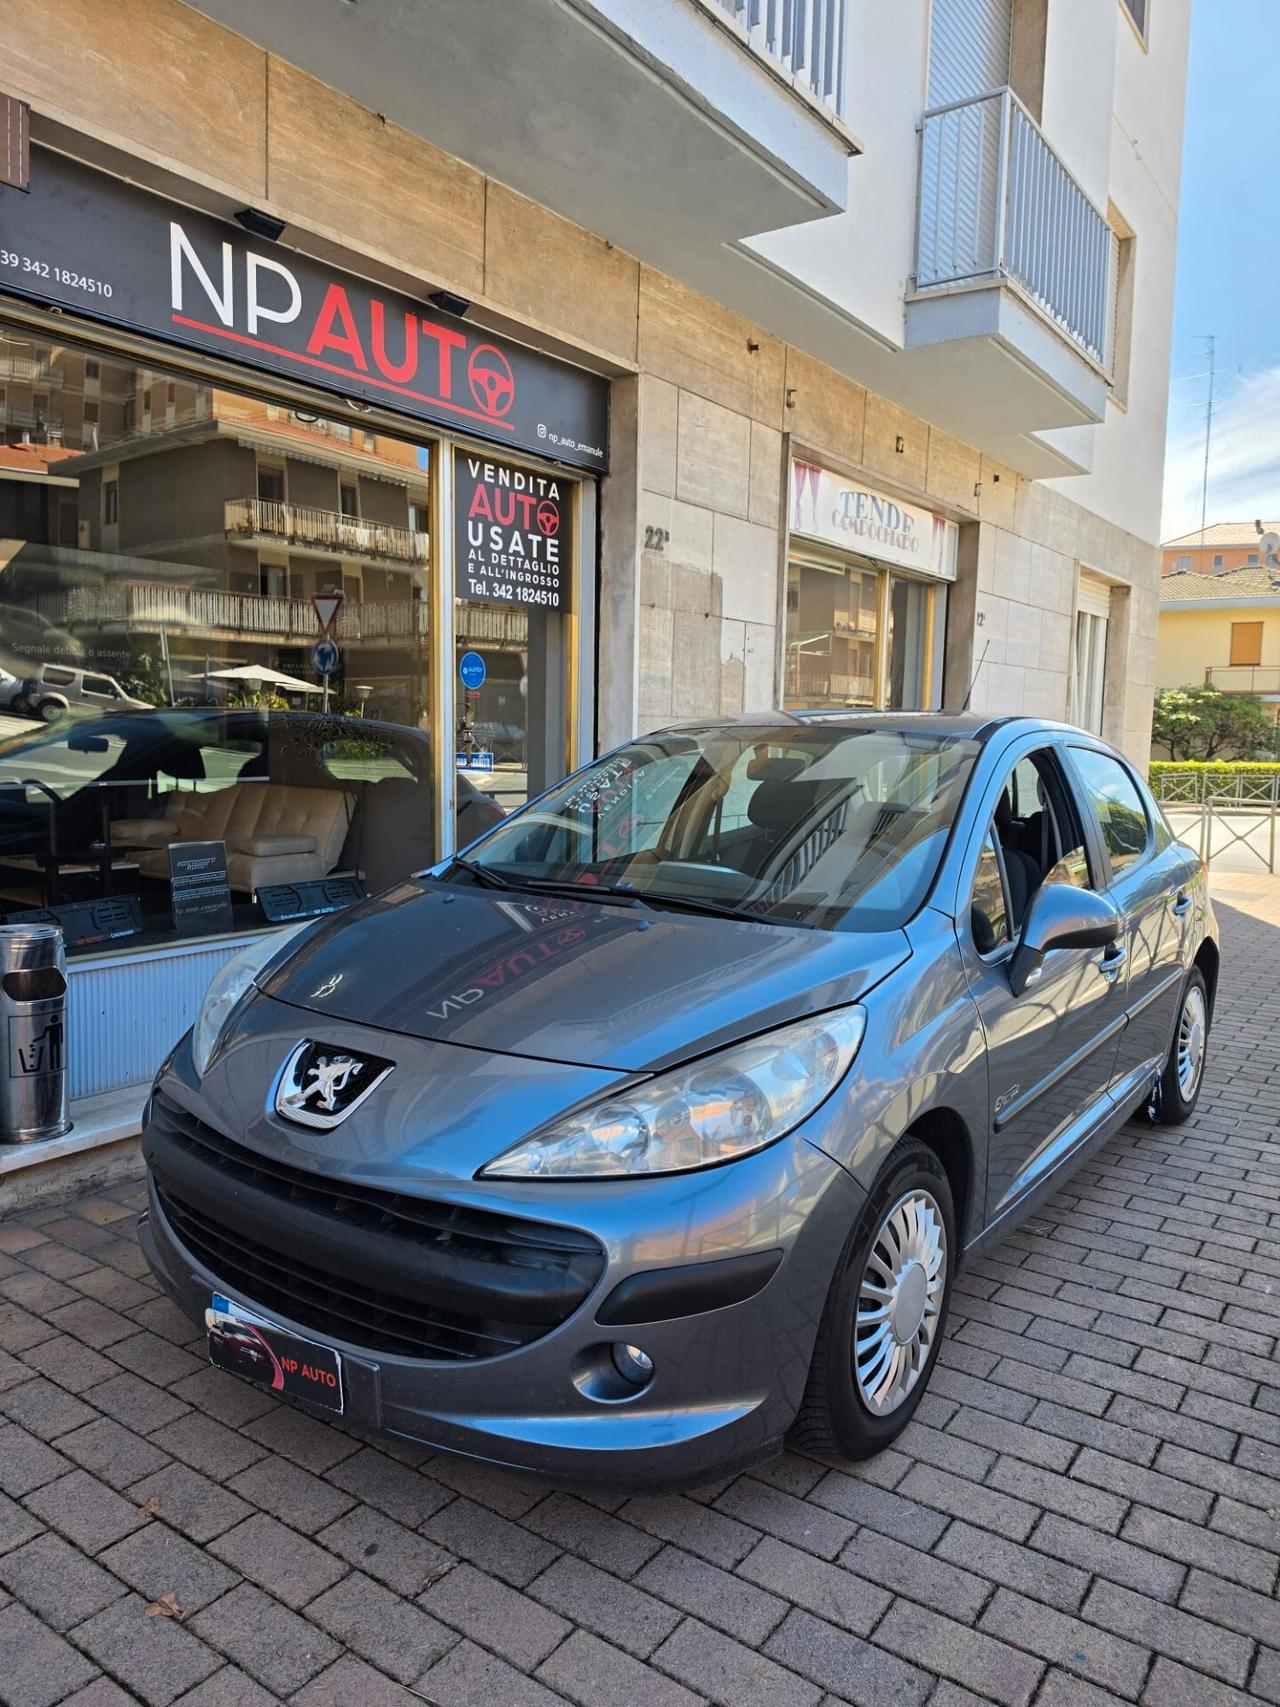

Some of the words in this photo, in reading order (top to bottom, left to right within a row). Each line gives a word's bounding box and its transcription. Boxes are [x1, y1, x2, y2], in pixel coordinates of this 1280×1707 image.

[22, 256, 50, 279] 342
[53, 267, 113, 299] 1824510
[169, 221, 302, 336] NP
[305, 283, 515, 417] AUTO
[467, 458, 560, 501] VENDITA
[467, 483, 560, 537] AUTO
[840, 491, 915, 534] TENDE
[467, 520, 560, 563] USATE
[468, 549, 485, 562] AL
[491, 552, 560, 576] DETTAGLIO
[467, 563, 475, 574] E
[480, 565, 560, 588] ALL'INGROSSO
[468, 578, 490, 597] Tel.
[492, 582, 513, 600] 342
[516, 586, 560, 607] 1824510
[11, 642, 51, 655] Segnale
[97, 648, 131, 659] assente
[281, 1356, 298, 1373] NP
[301, 1364, 337, 1388] AUTO
